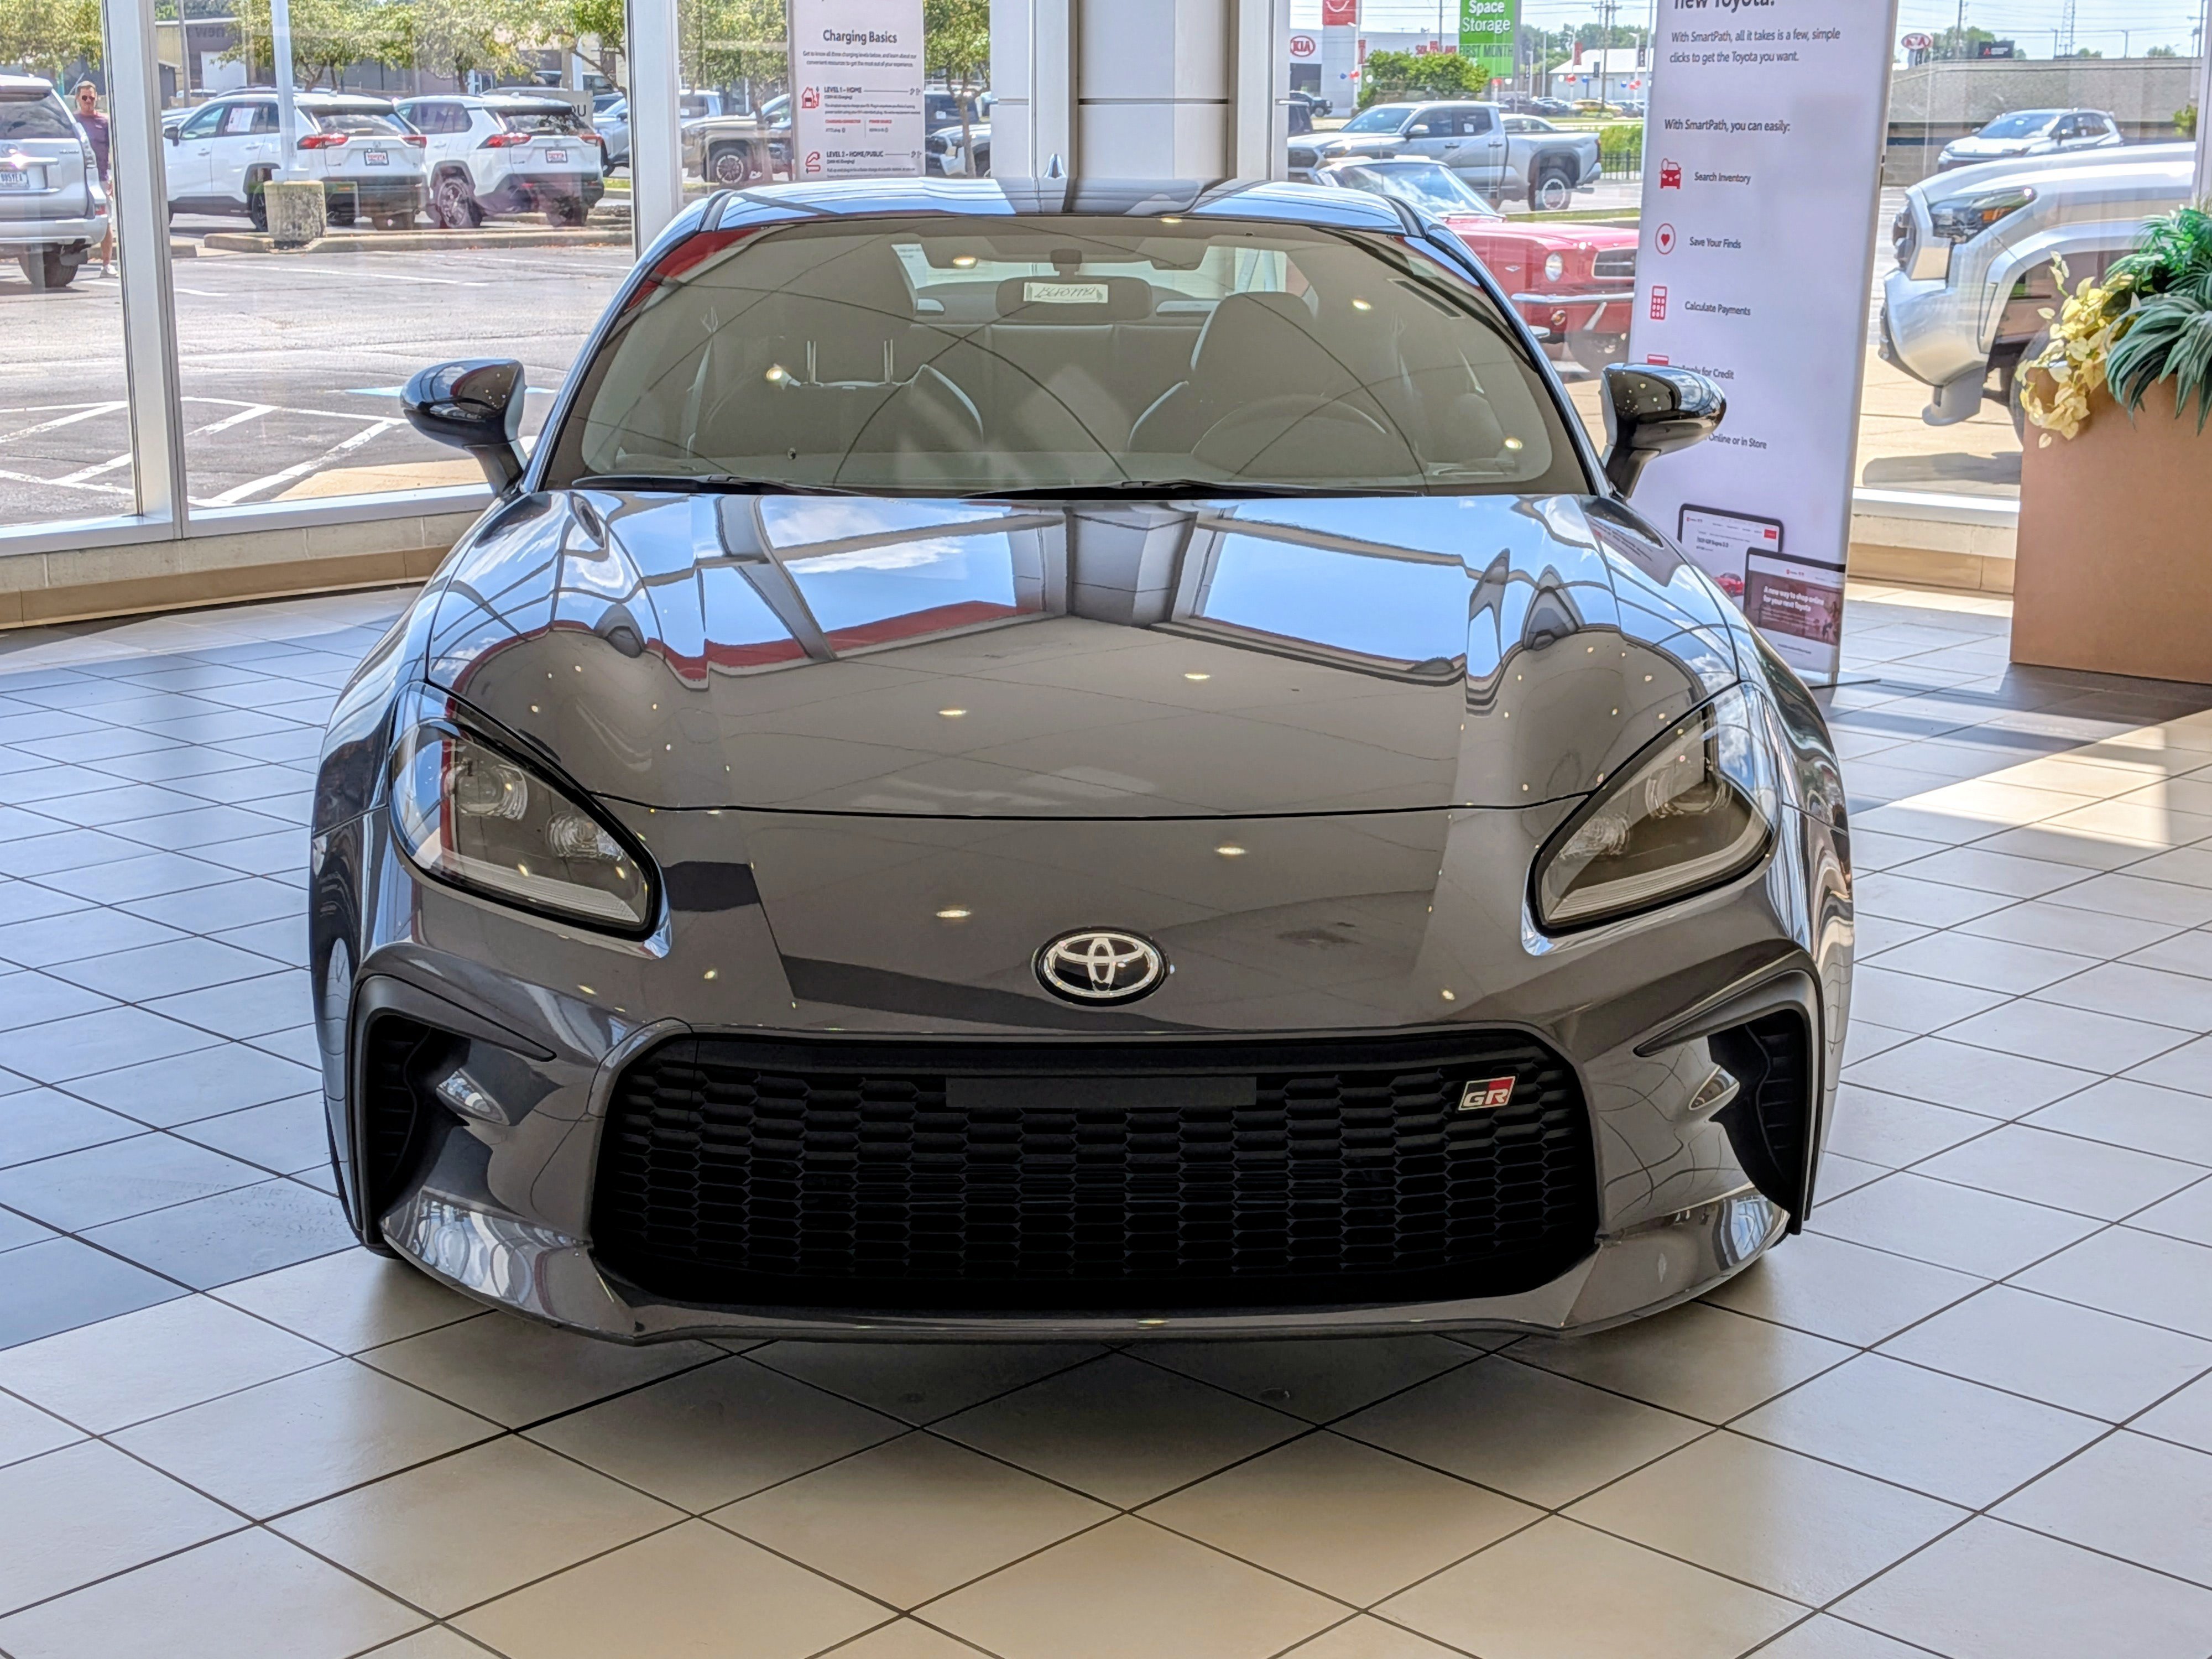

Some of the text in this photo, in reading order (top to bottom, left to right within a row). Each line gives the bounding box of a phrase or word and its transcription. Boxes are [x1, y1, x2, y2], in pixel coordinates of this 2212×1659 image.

[1469, 0, 1505, 17] Space
[1674, 0, 1707, 9] new
[1462, 17, 1510, 33] Storage
[823, 29, 897, 45] Charging Basics
[1671, 28, 1840, 43] With SmartPath, all it takes is a few, simple
[1293, 40, 1311, 52] KIA
[1670, 51, 1799, 65] clicks to get the Toyota you want.
[1665, 119, 1790, 134] With SmartPath, you can easily:
[1694, 171, 1751, 185] Search Inventory
[1689, 237, 1741, 249] Save Your Finds
[1685, 301, 1751, 316] Calculate Payments
[1702, 367, 1712, 377] for
[1713, 368, 1734, 379] Credit
[1709, 433, 1730, 444] Online
[1742, 436, 1747, 446] in
[1749, 438, 1767, 449] Store
[1779, 591, 1790, 599] way
[1796, 593, 1808, 603] shop
[1795, 601, 1811, 612] Toyota
[1463, 1088, 1509, 1107] GR
